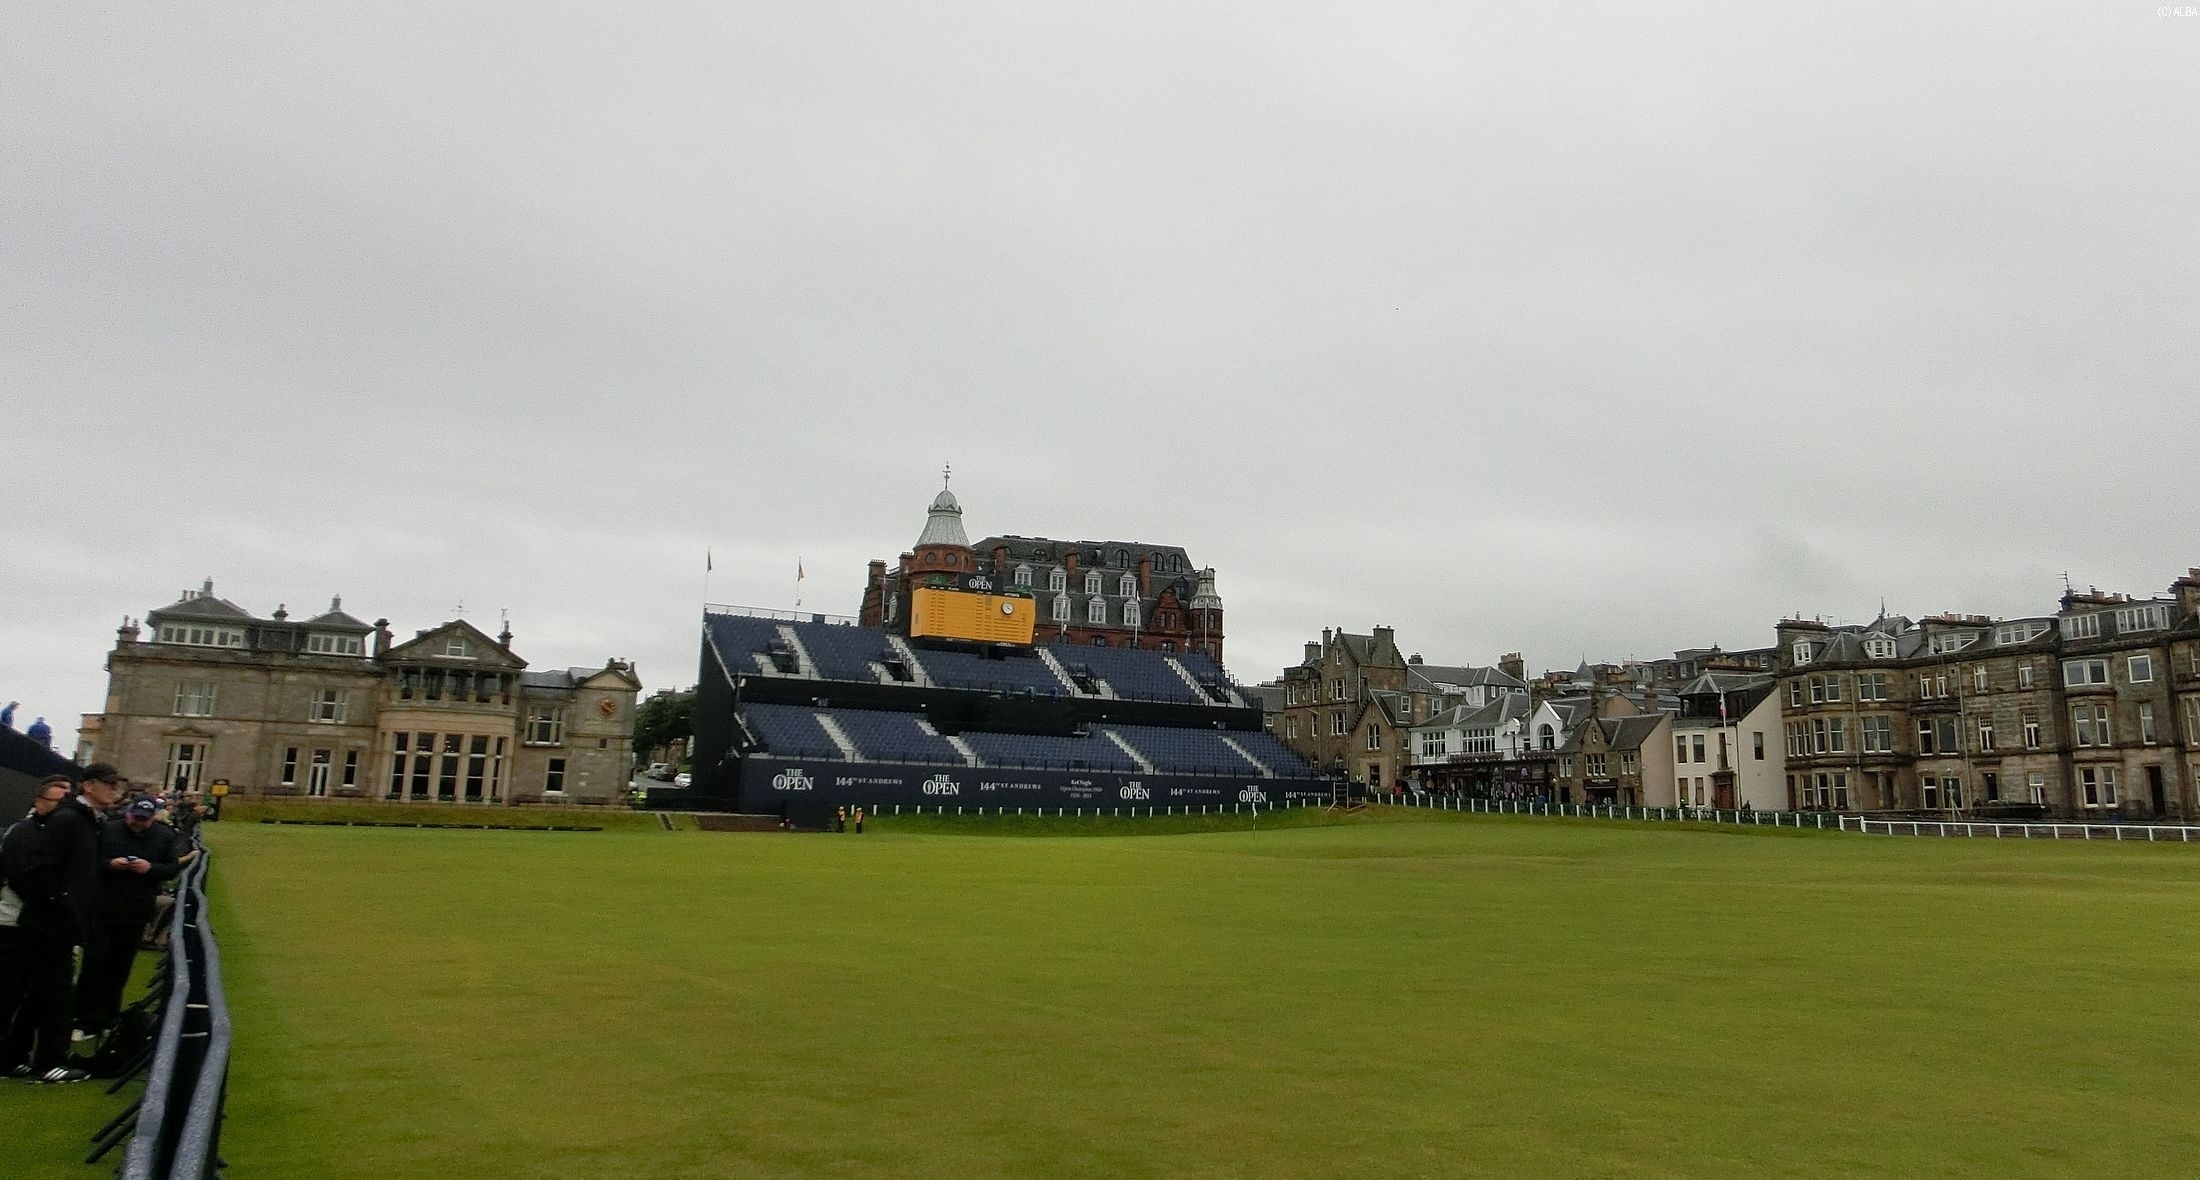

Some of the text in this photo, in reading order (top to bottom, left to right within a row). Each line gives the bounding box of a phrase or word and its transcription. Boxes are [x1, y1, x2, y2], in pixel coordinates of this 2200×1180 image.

[968, 578, 993, 590] OPEN
[785, 768, 803, 777] THE
[933, 774, 950, 782] THE
[772, 774, 815, 790] OPEN
[922, 779, 960, 795] OPEN
[1129, 781, 1142, 789] THE
[1119, 786, 1150, 800] OPEN
[1238, 789, 1267, 803] OPEN
